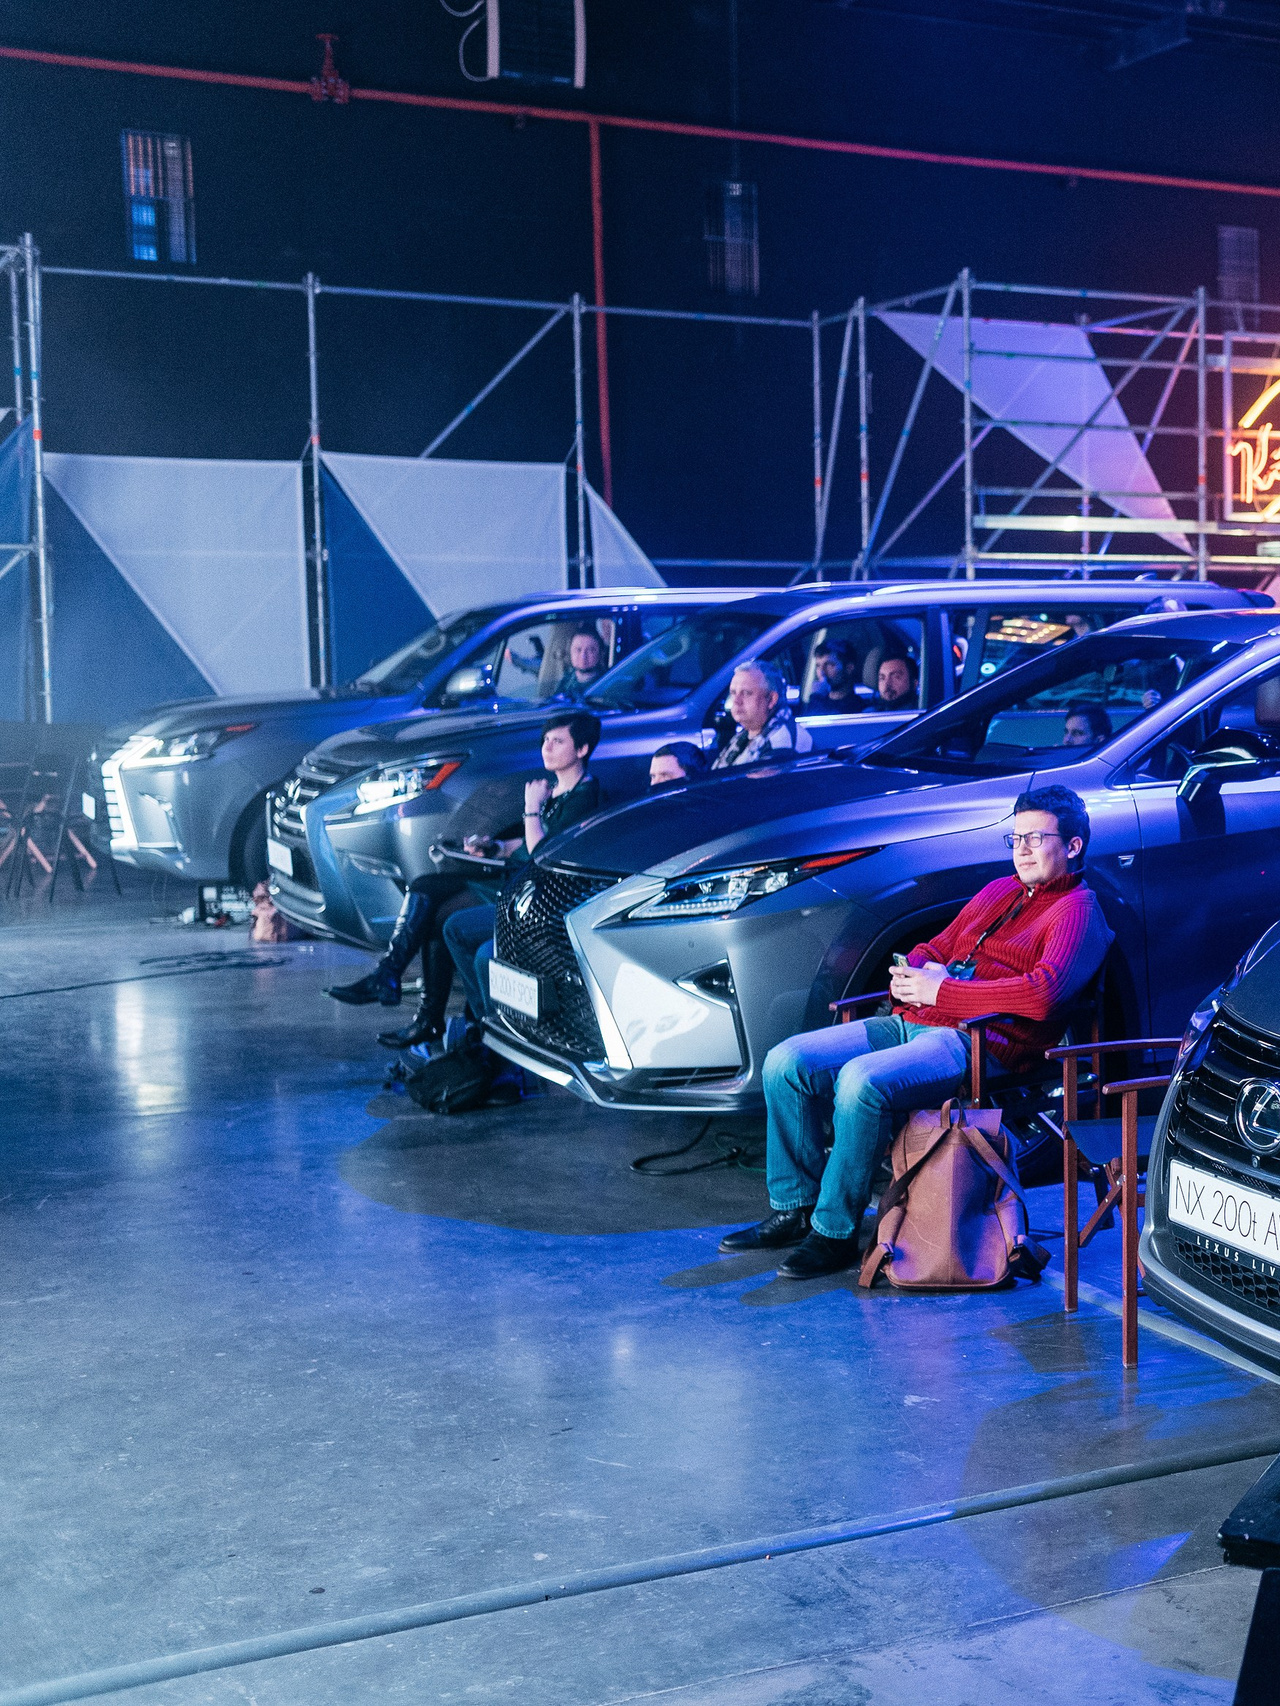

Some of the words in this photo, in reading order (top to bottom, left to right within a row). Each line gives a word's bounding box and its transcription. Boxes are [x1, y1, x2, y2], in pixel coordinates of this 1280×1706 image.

[1175, 1175, 1206, 1221] NX
[1212, 1190, 1258, 1242] 200t
[1196, 1235, 1240, 1262] LEXUS
